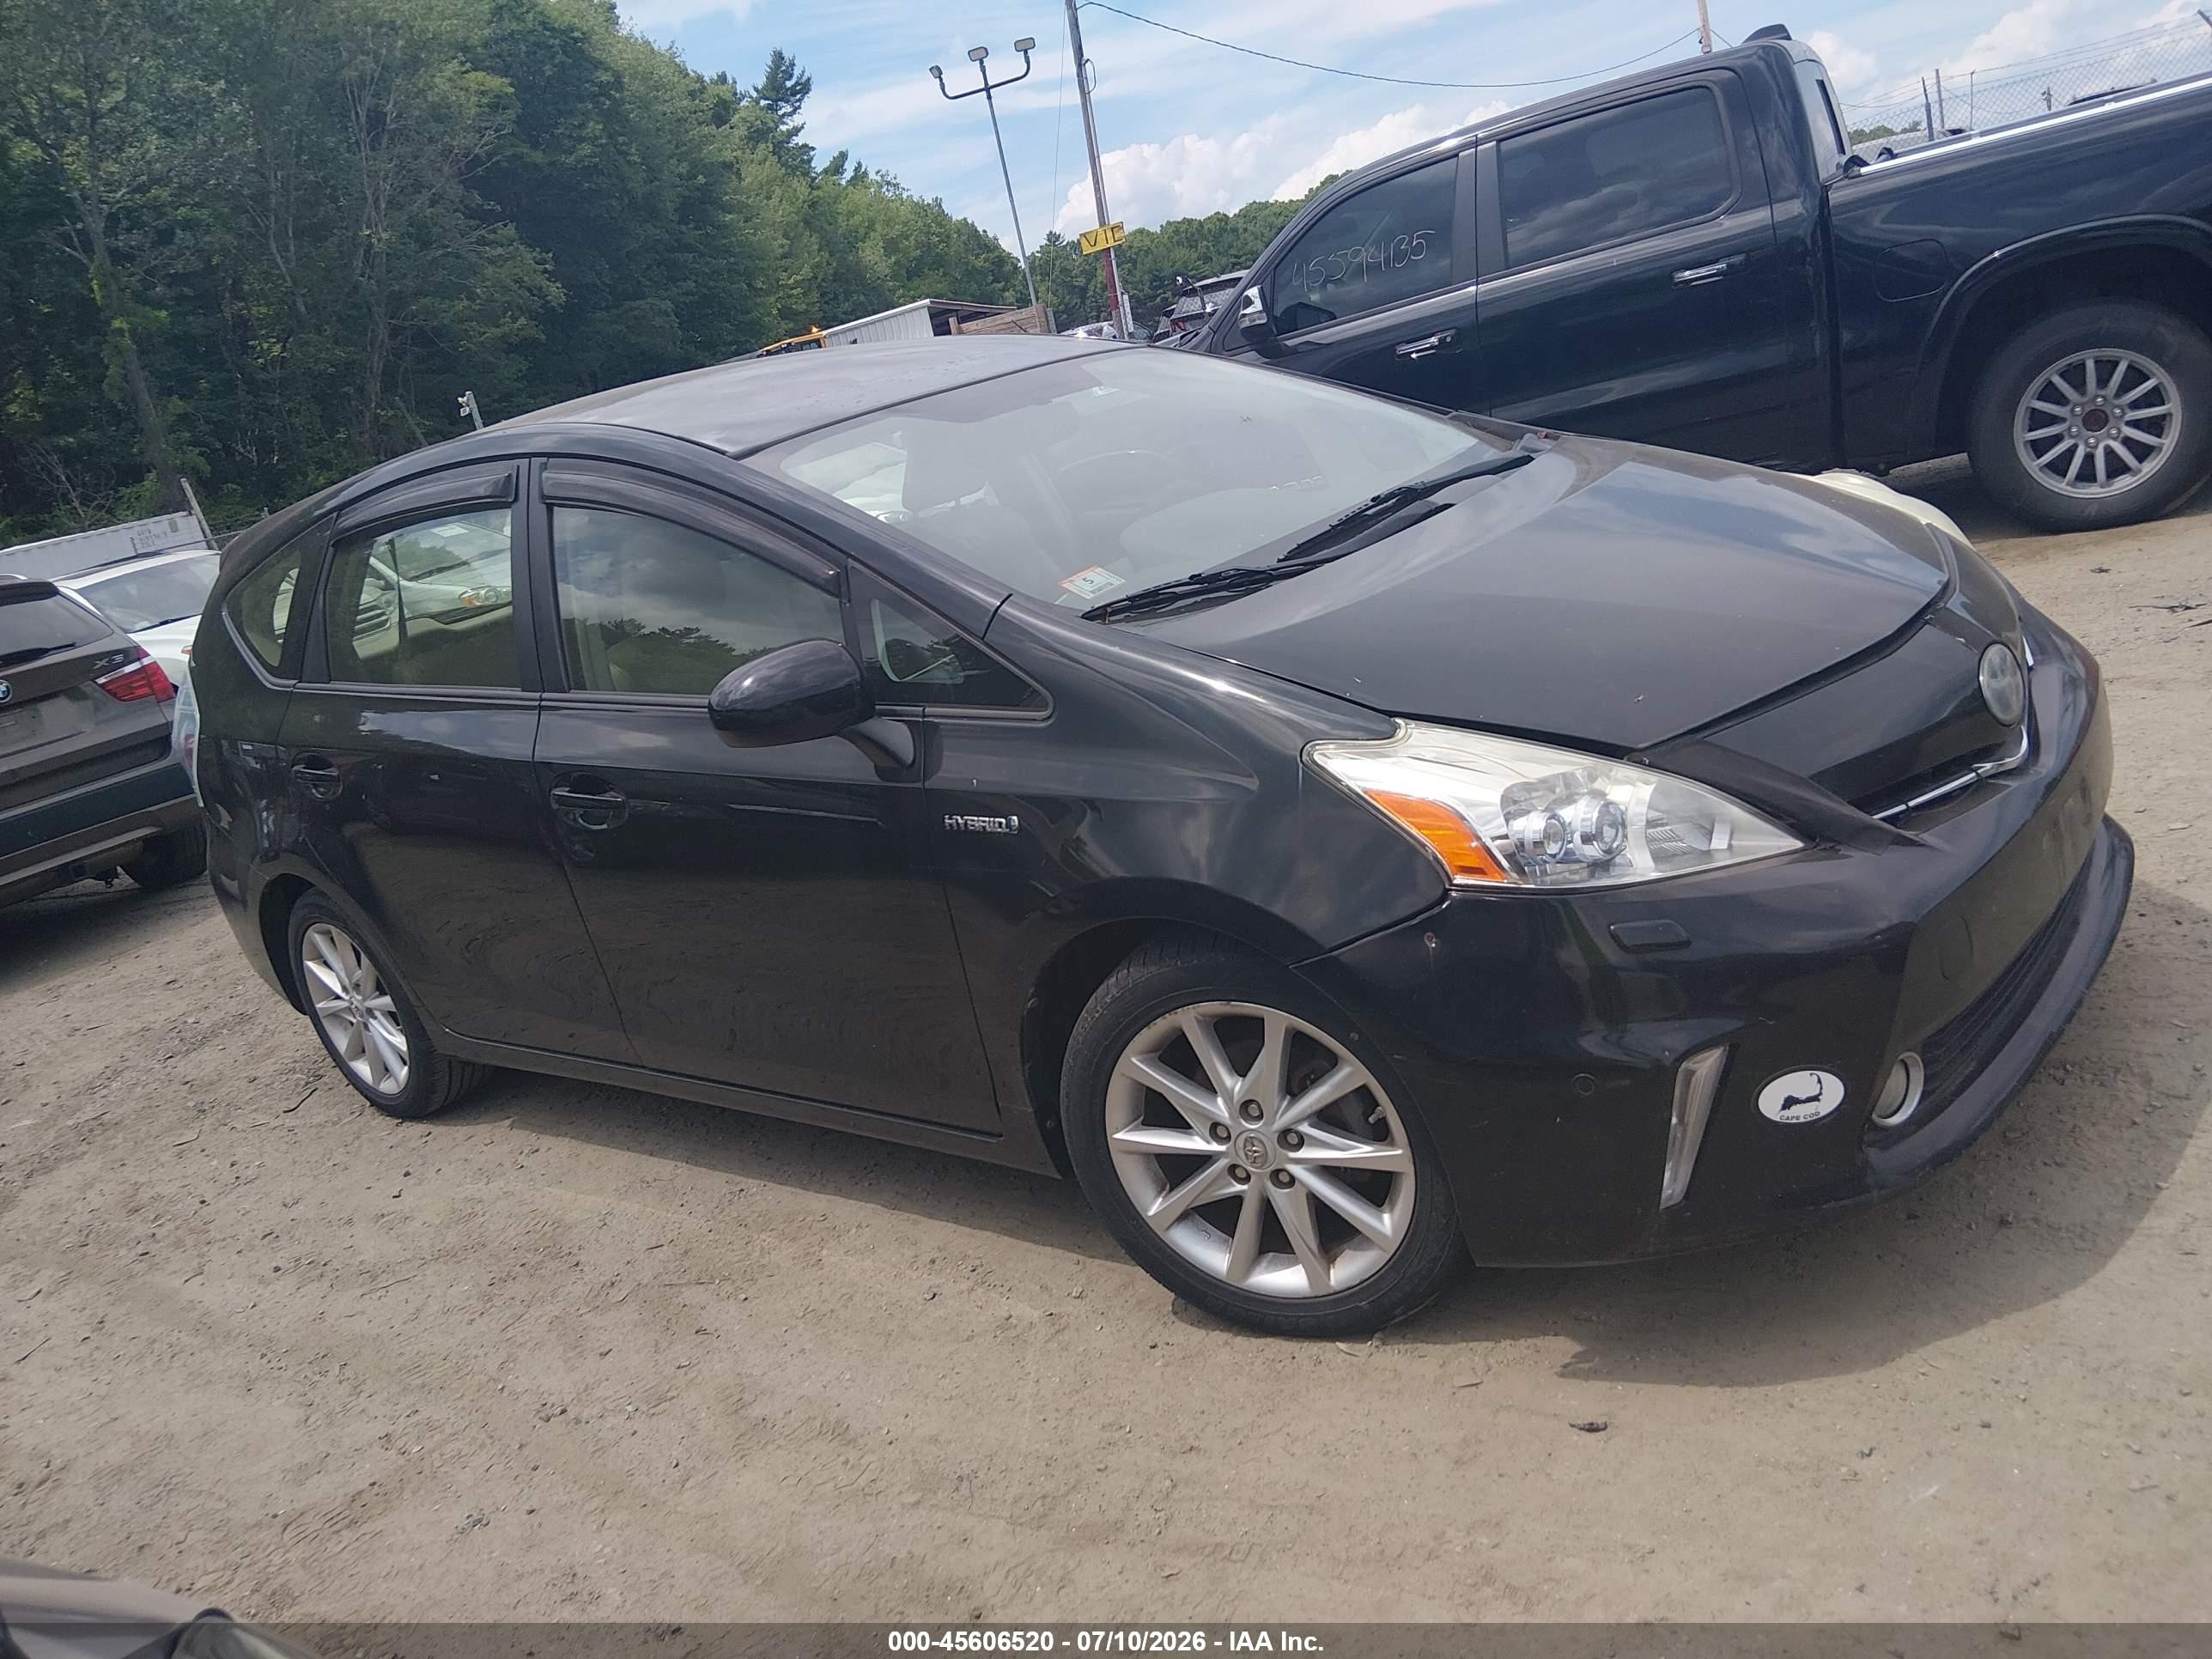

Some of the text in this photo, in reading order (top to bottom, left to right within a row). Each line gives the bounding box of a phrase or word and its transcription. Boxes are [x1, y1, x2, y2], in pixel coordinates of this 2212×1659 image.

[93, 653, 125, 670] X3
[944, 815, 1006, 832] HYBRID
[1802, 1111, 1820, 1120] COD
